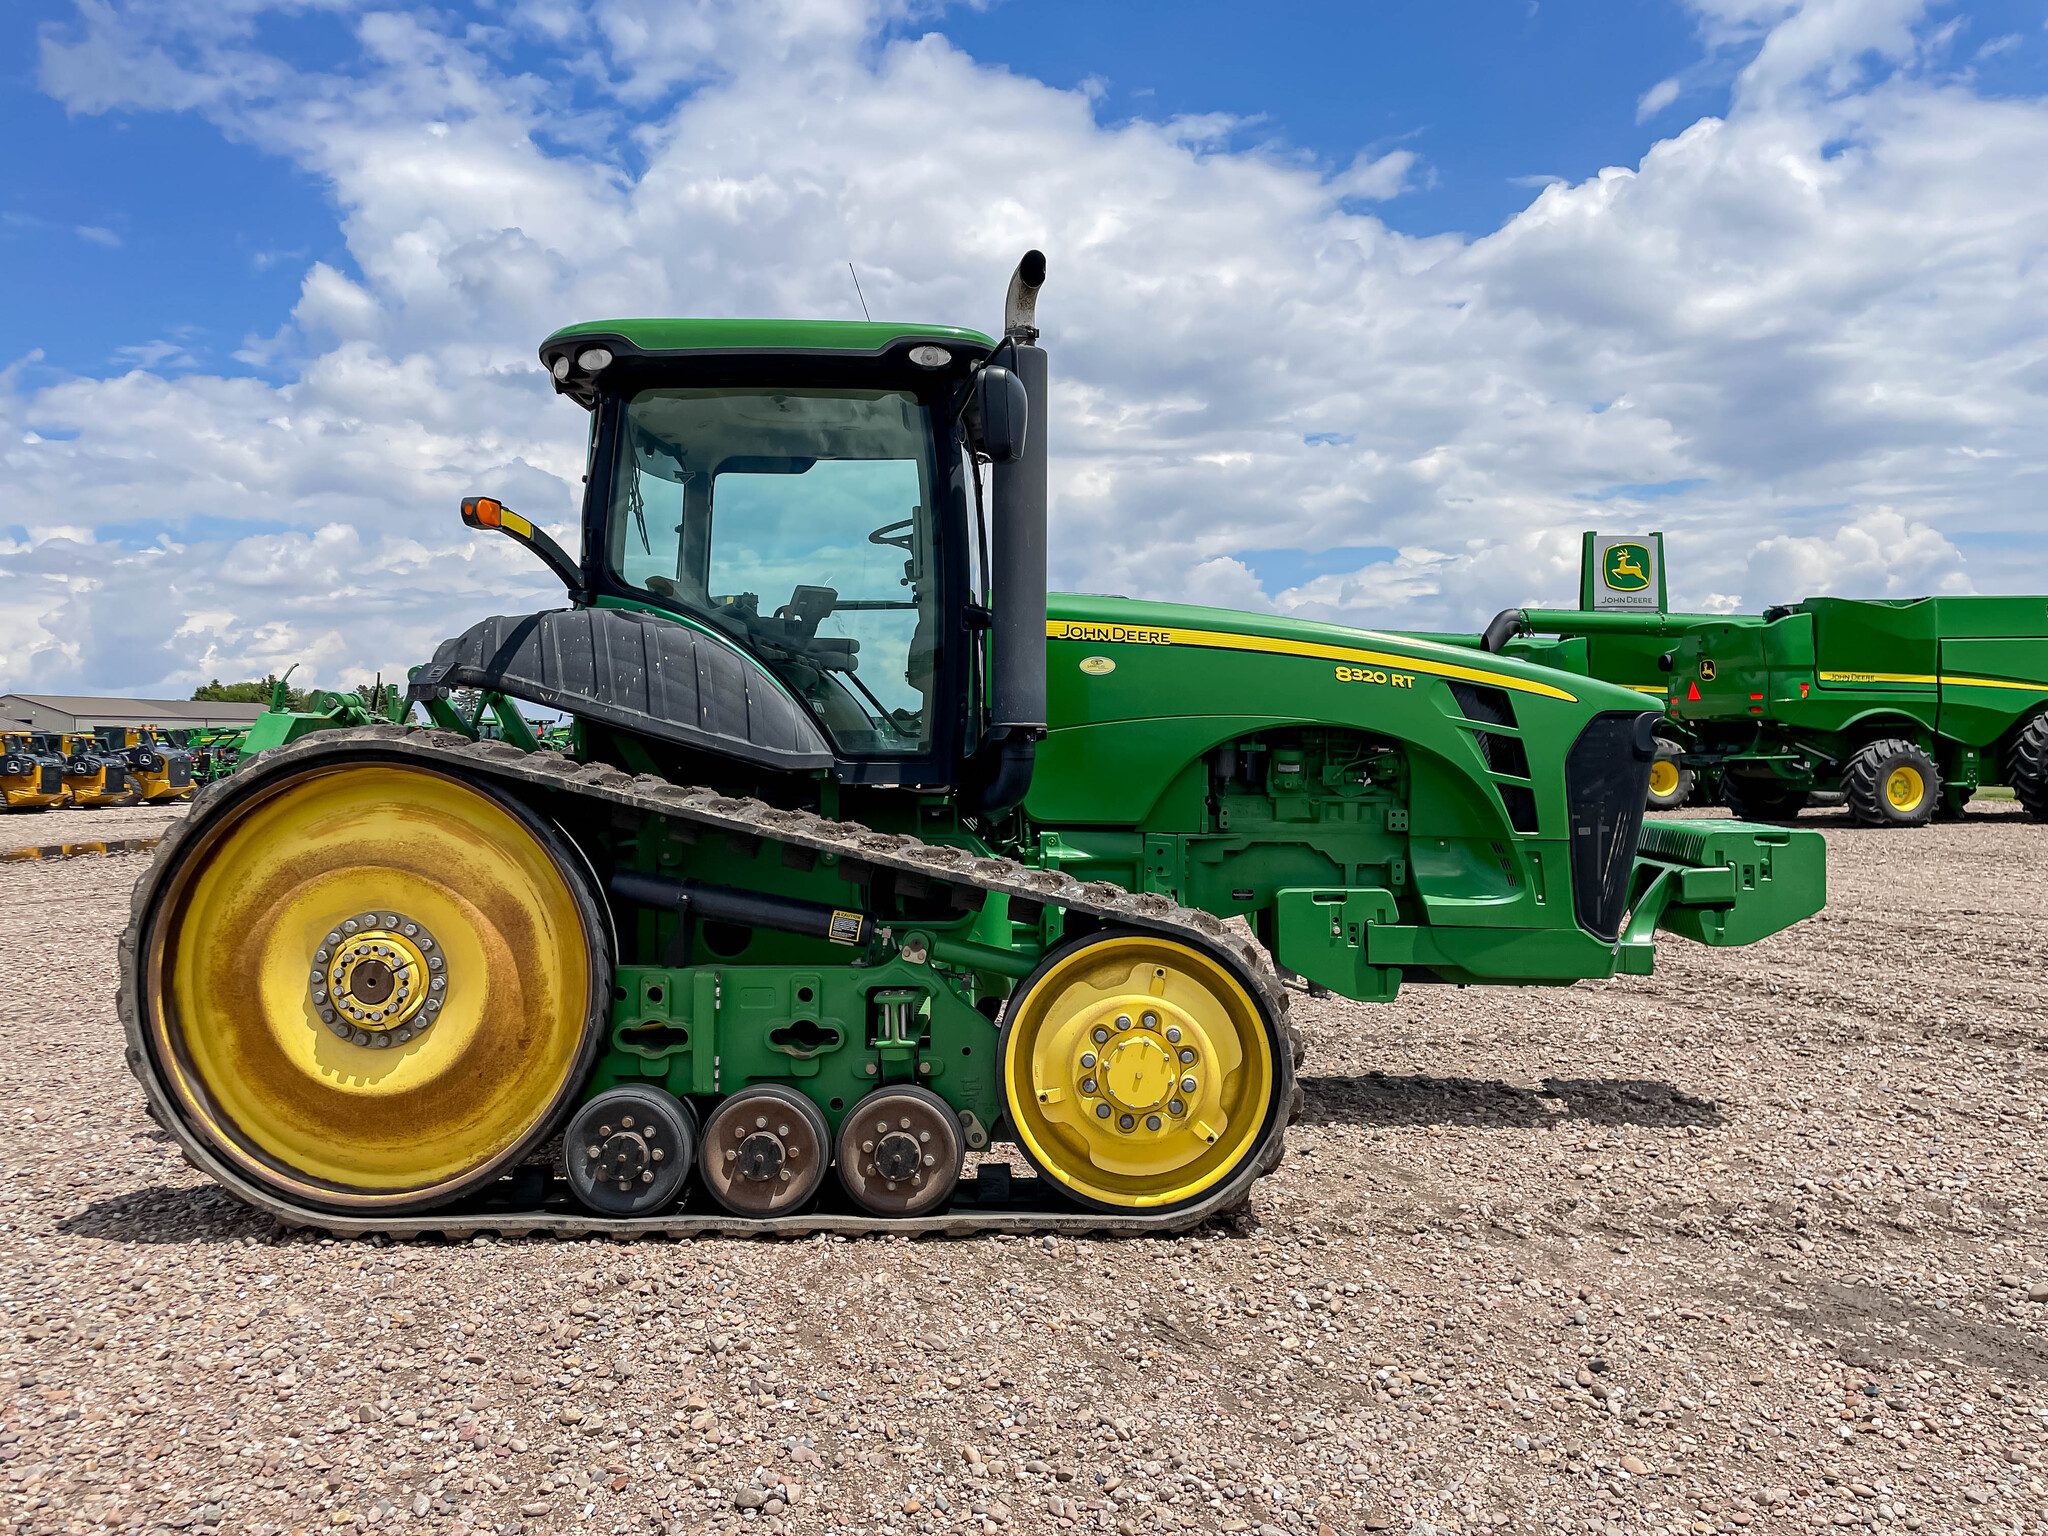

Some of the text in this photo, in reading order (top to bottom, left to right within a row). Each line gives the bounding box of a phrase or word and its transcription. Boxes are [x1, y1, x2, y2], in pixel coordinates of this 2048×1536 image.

[1601, 596, 1653, 604] JOHN DEERE
[1059, 624, 1171, 643] JOHN DEERE
[1335, 666, 1416, 689] 8320 RT
[1830, 673, 1876, 682] JOHN DEERE
